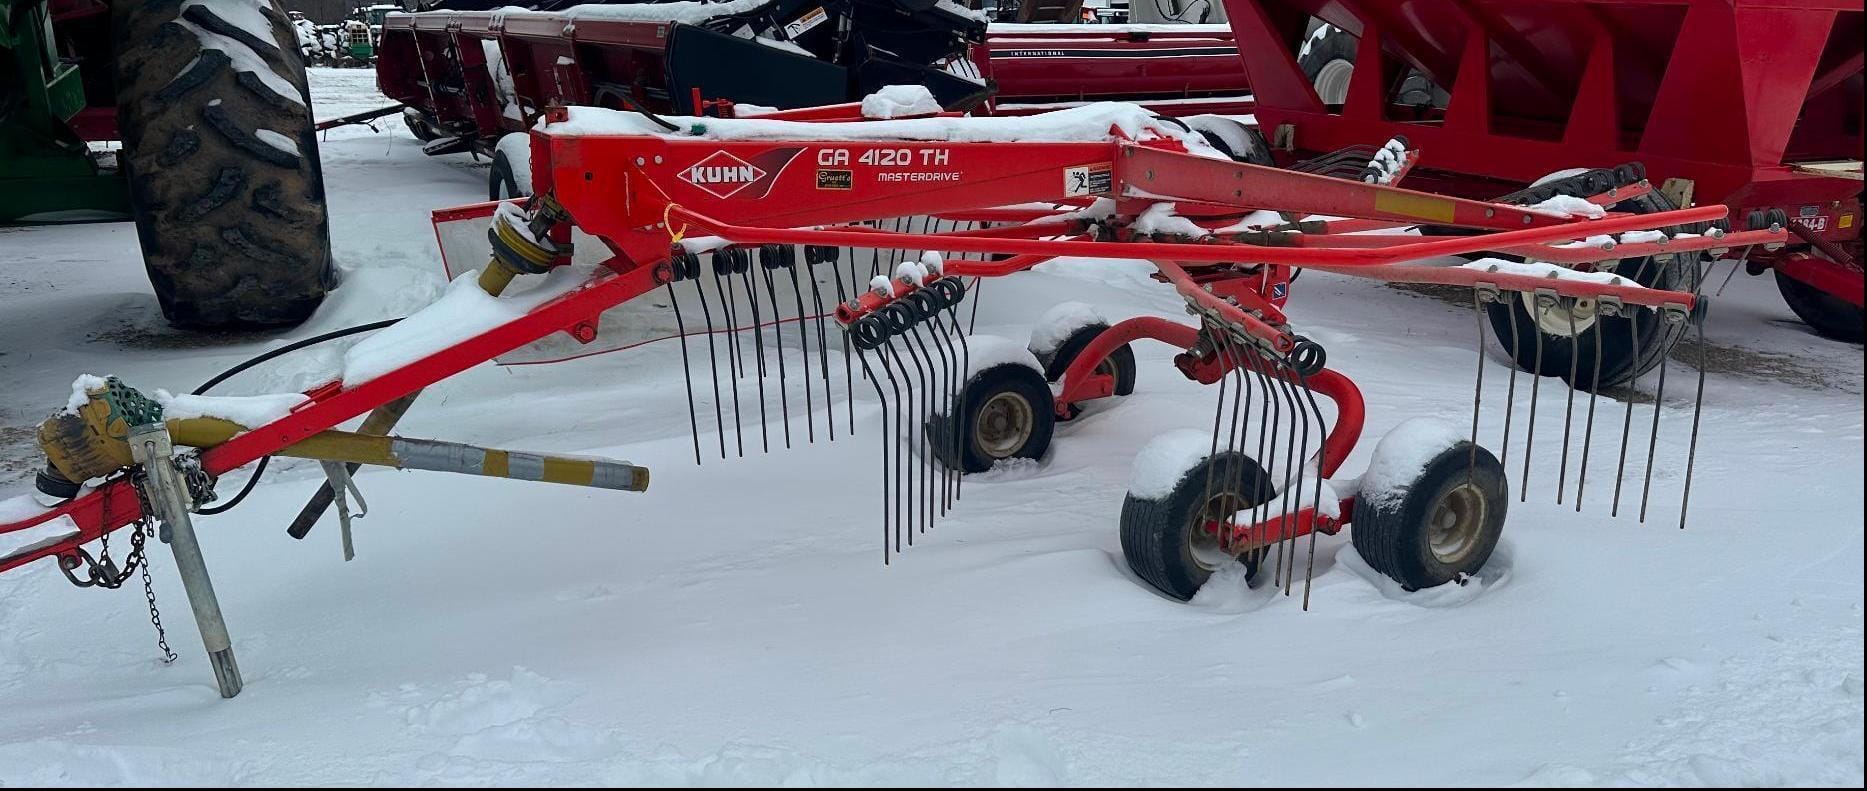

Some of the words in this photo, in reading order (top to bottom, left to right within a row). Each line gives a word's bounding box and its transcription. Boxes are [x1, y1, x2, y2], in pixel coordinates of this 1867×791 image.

[817, 148, 849, 166] GA
[858, 148, 912, 166] 4120
[919, 148, 949, 166] TH
[691, 166, 754, 183] KUHN
[878, 172, 960, 182] MASTERDRIVE
